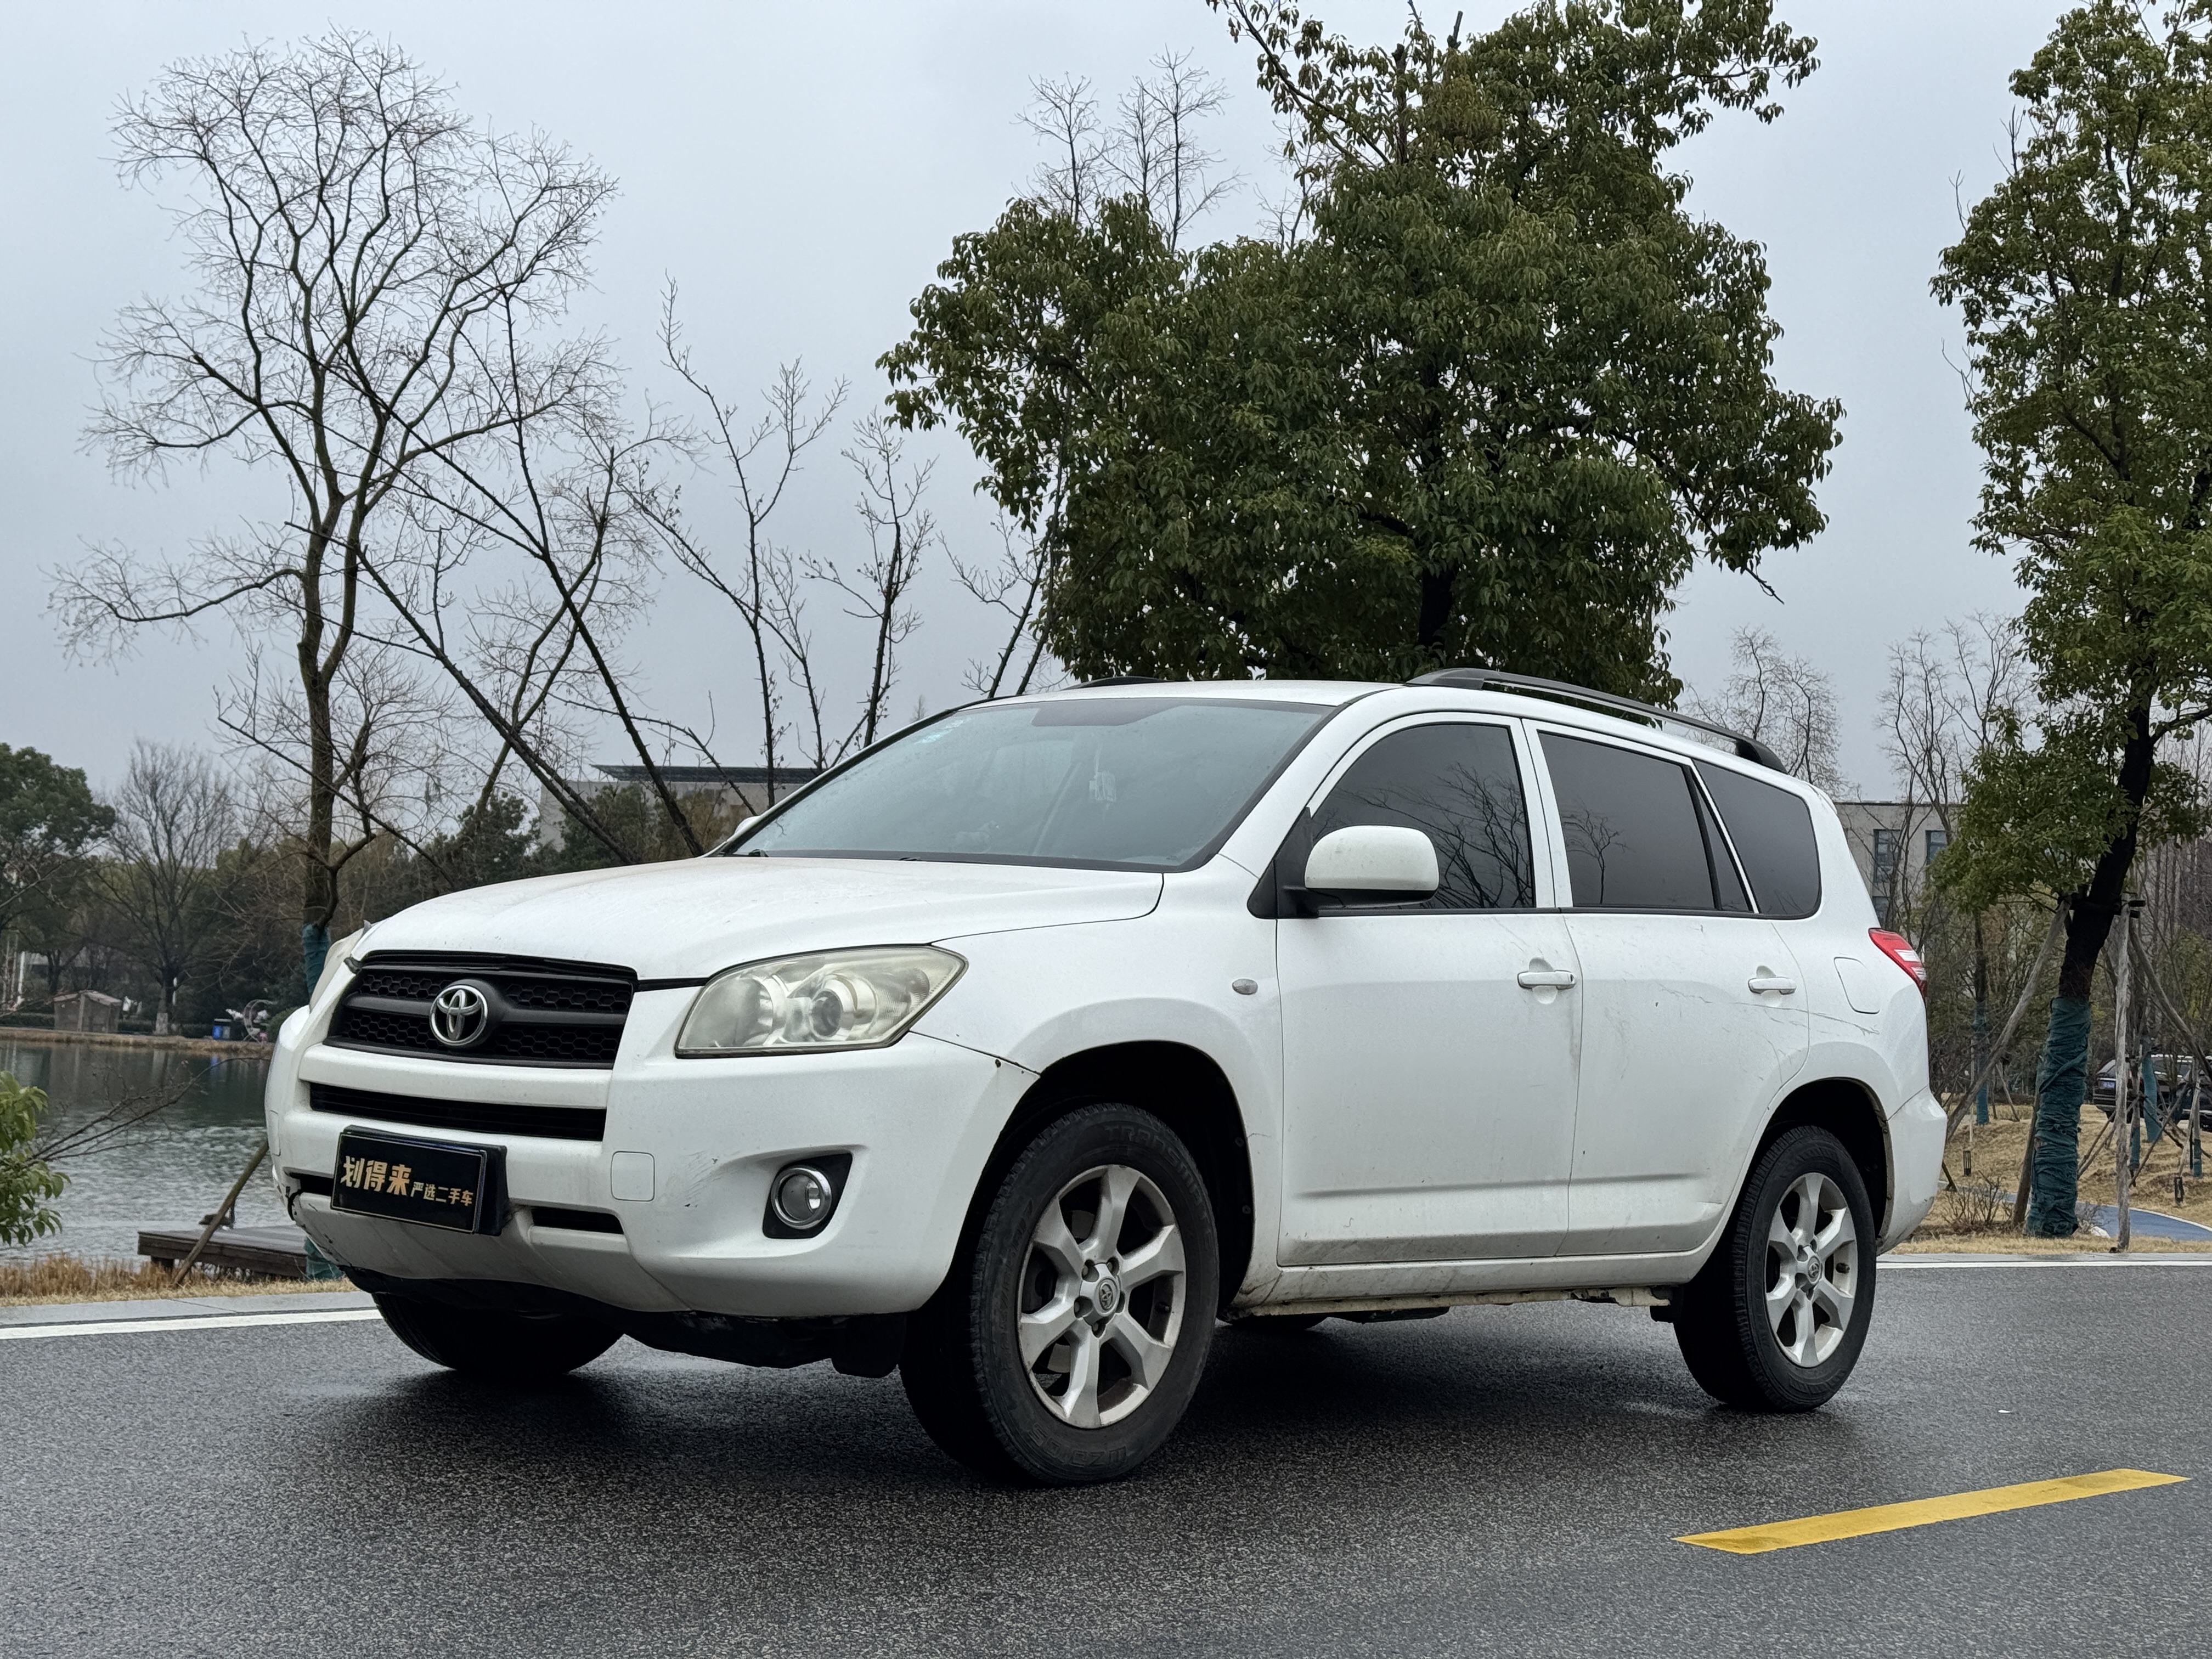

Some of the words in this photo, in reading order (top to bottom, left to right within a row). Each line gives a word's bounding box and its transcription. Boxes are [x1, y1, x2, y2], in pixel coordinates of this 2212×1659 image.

[340, 1155, 411, 1197] 划得来
[410, 1181, 473, 1206] 严选二手车
